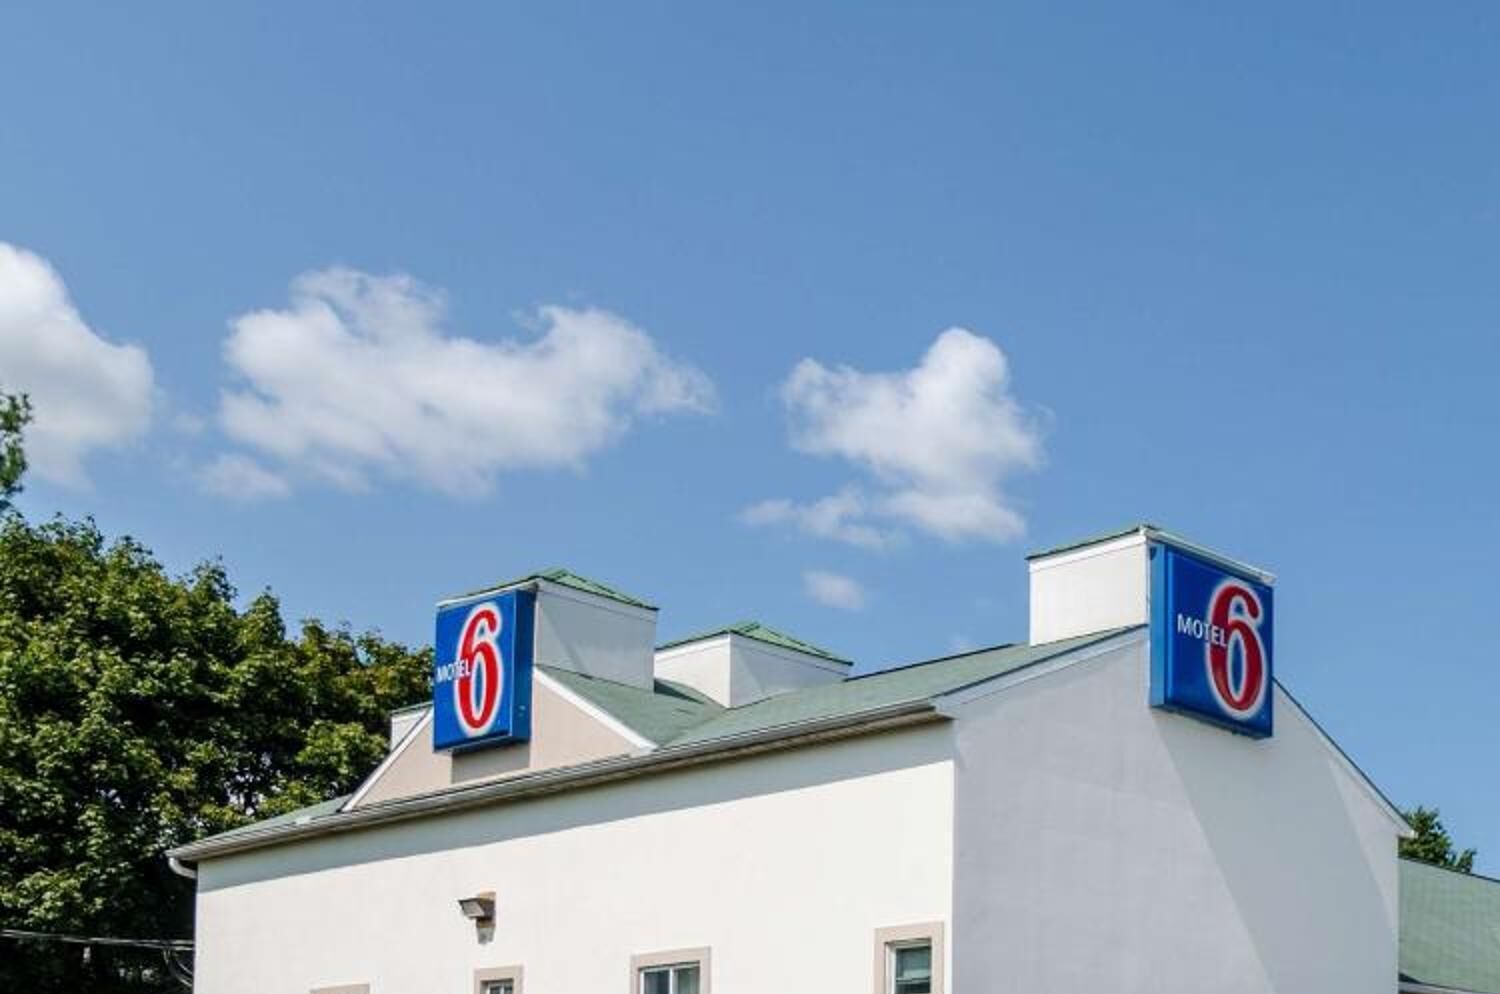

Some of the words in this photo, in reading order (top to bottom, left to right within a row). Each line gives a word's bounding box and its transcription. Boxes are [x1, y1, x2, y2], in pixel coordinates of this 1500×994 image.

[436, 658, 471, 684] MOTEL
[455, 602, 503, 737] 6
[1177, 613, 1228, 648] MOTEL
[1206, 576, 1267, 720] 6
